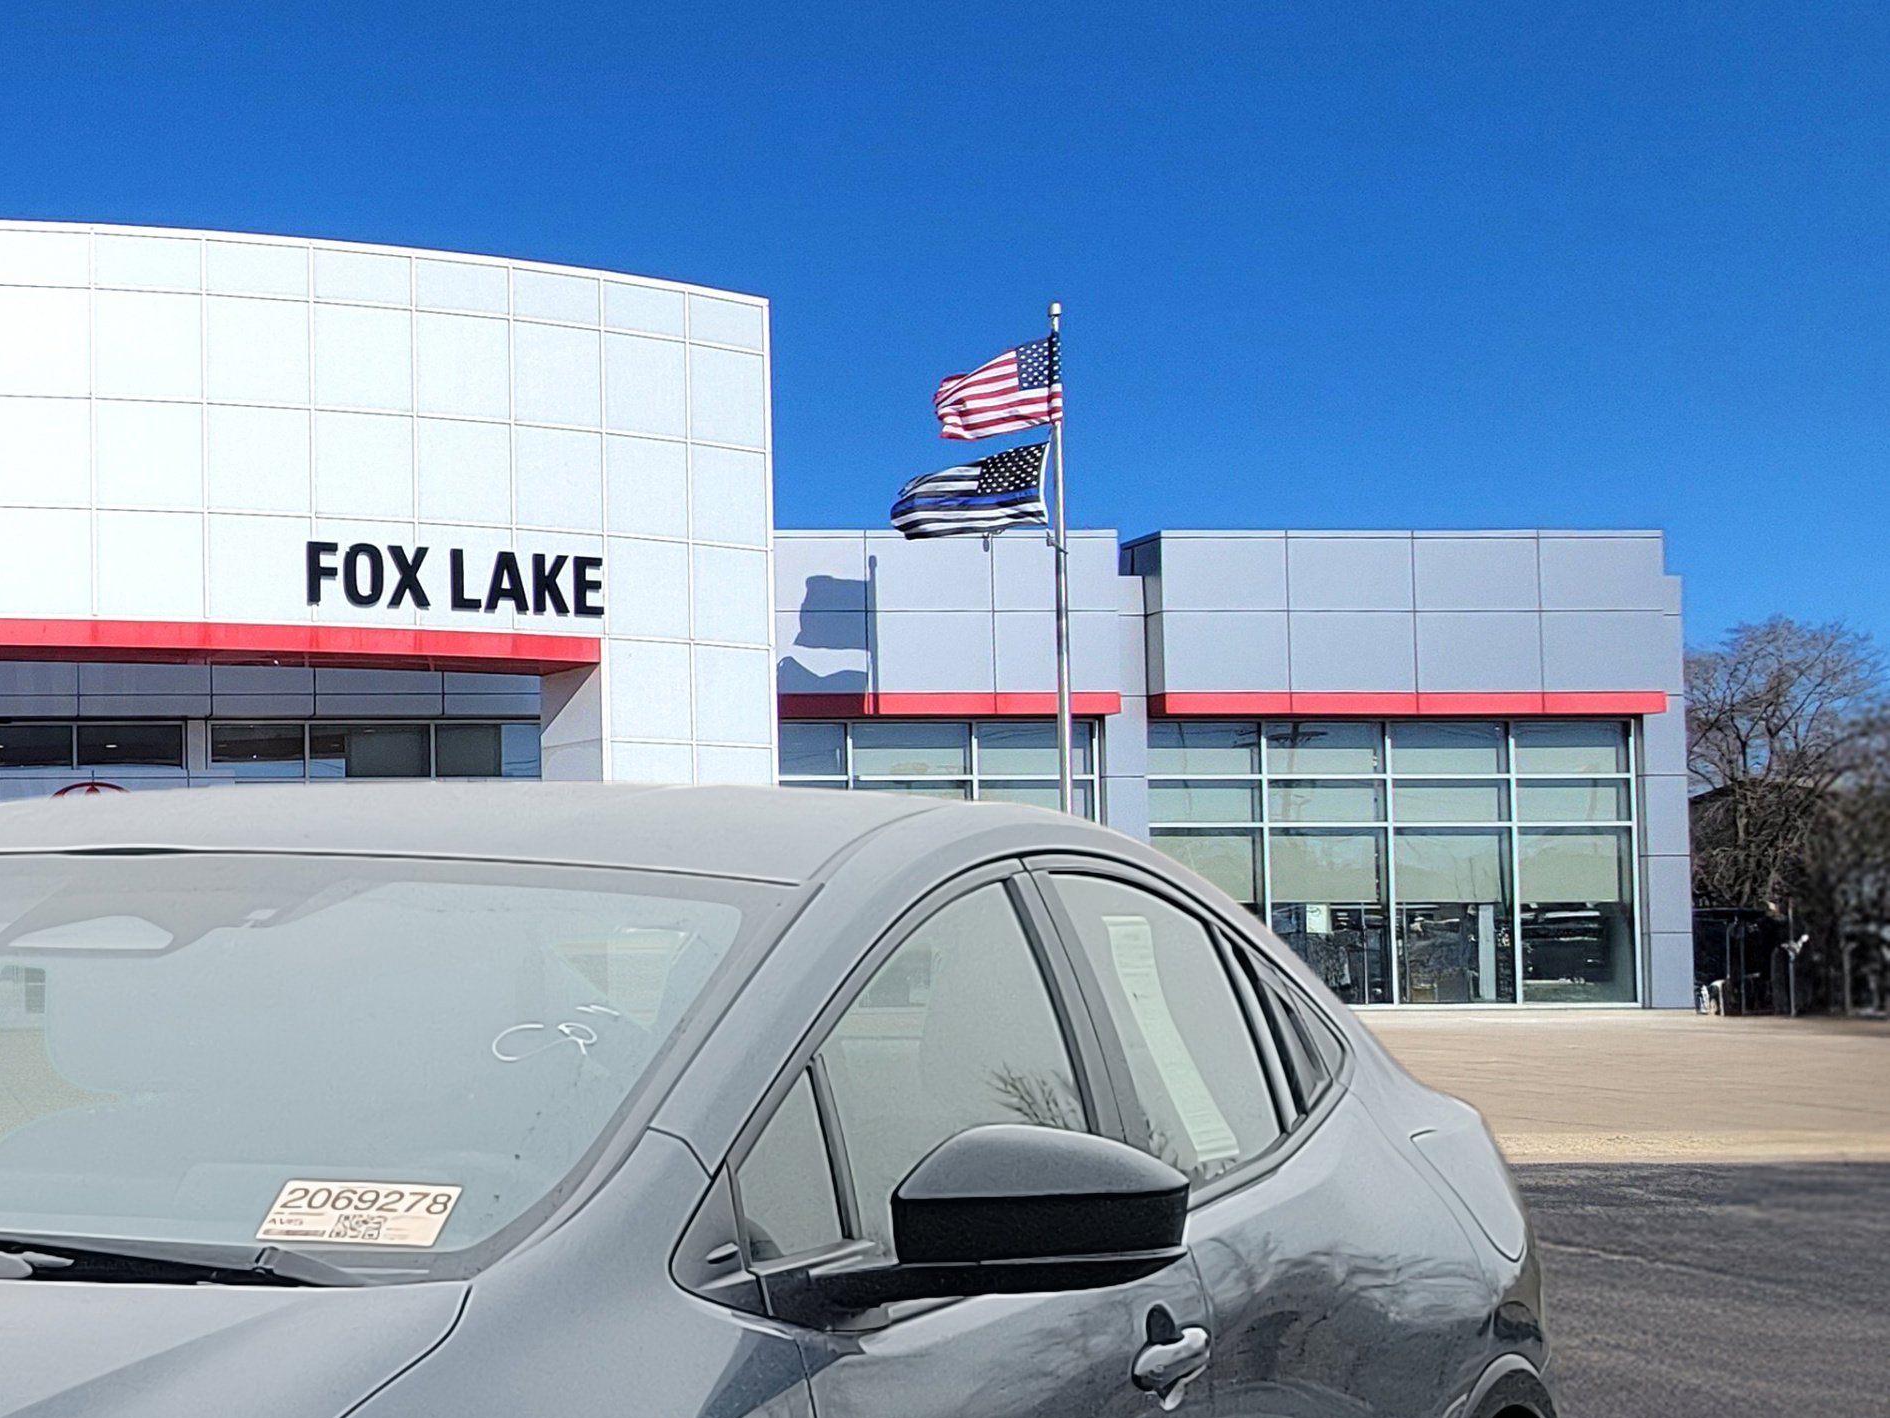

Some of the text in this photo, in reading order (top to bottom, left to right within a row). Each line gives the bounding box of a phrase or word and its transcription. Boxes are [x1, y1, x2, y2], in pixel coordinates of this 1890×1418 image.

[306, 541, 605, 616] FOX LAKE
[280, 1187, 452, 1214] 2069278
